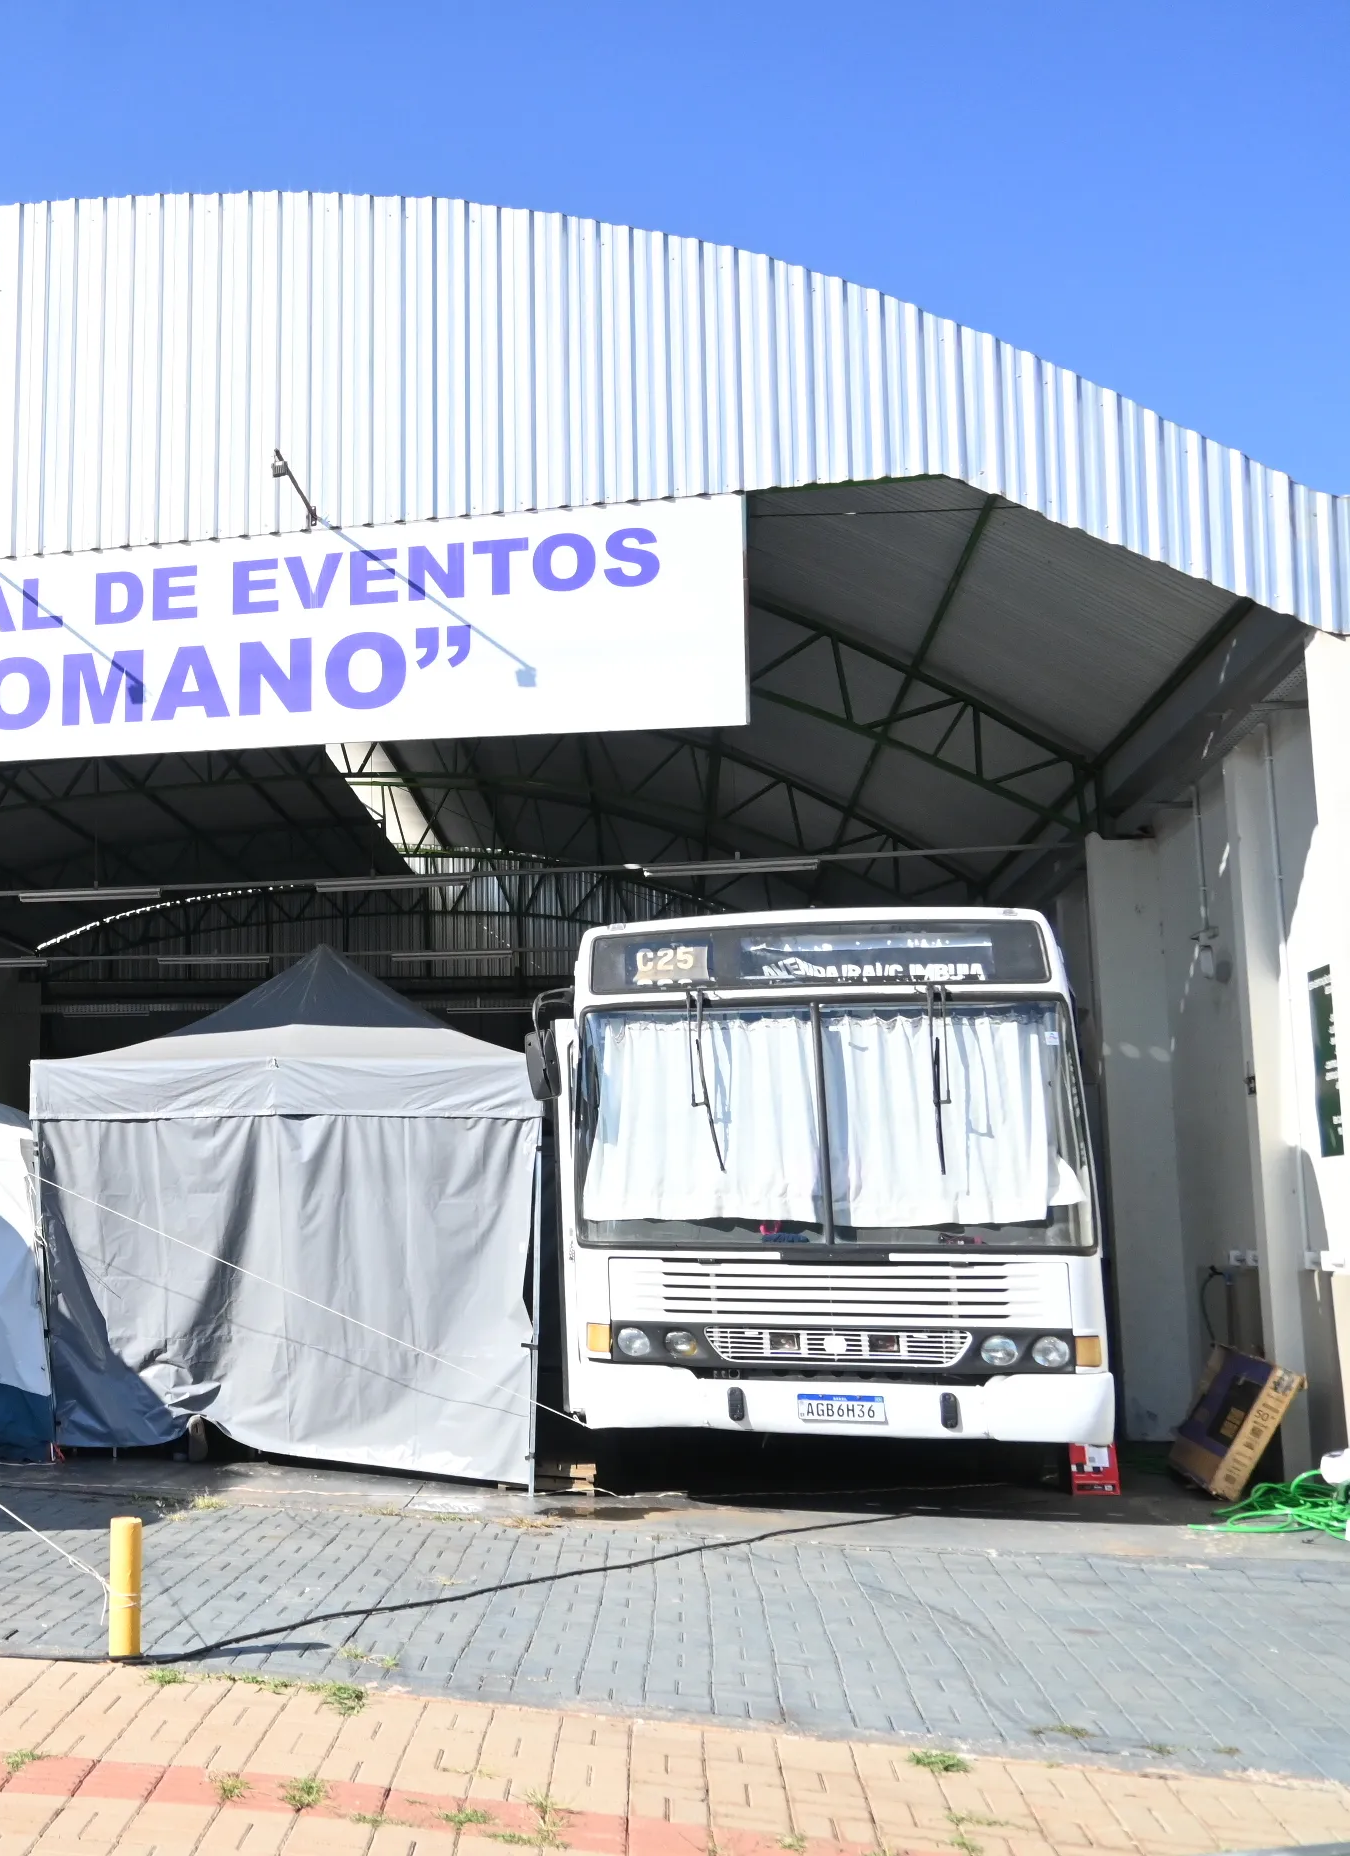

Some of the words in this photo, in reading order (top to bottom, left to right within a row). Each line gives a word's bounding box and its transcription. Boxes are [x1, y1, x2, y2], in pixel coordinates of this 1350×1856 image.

[95, 565, 198, 625] DE
[232, 527, 661, 616] EVENTOS
[636, 945, 694, 972] C25
[807, 1402, 876, 1419] AGB6H36
